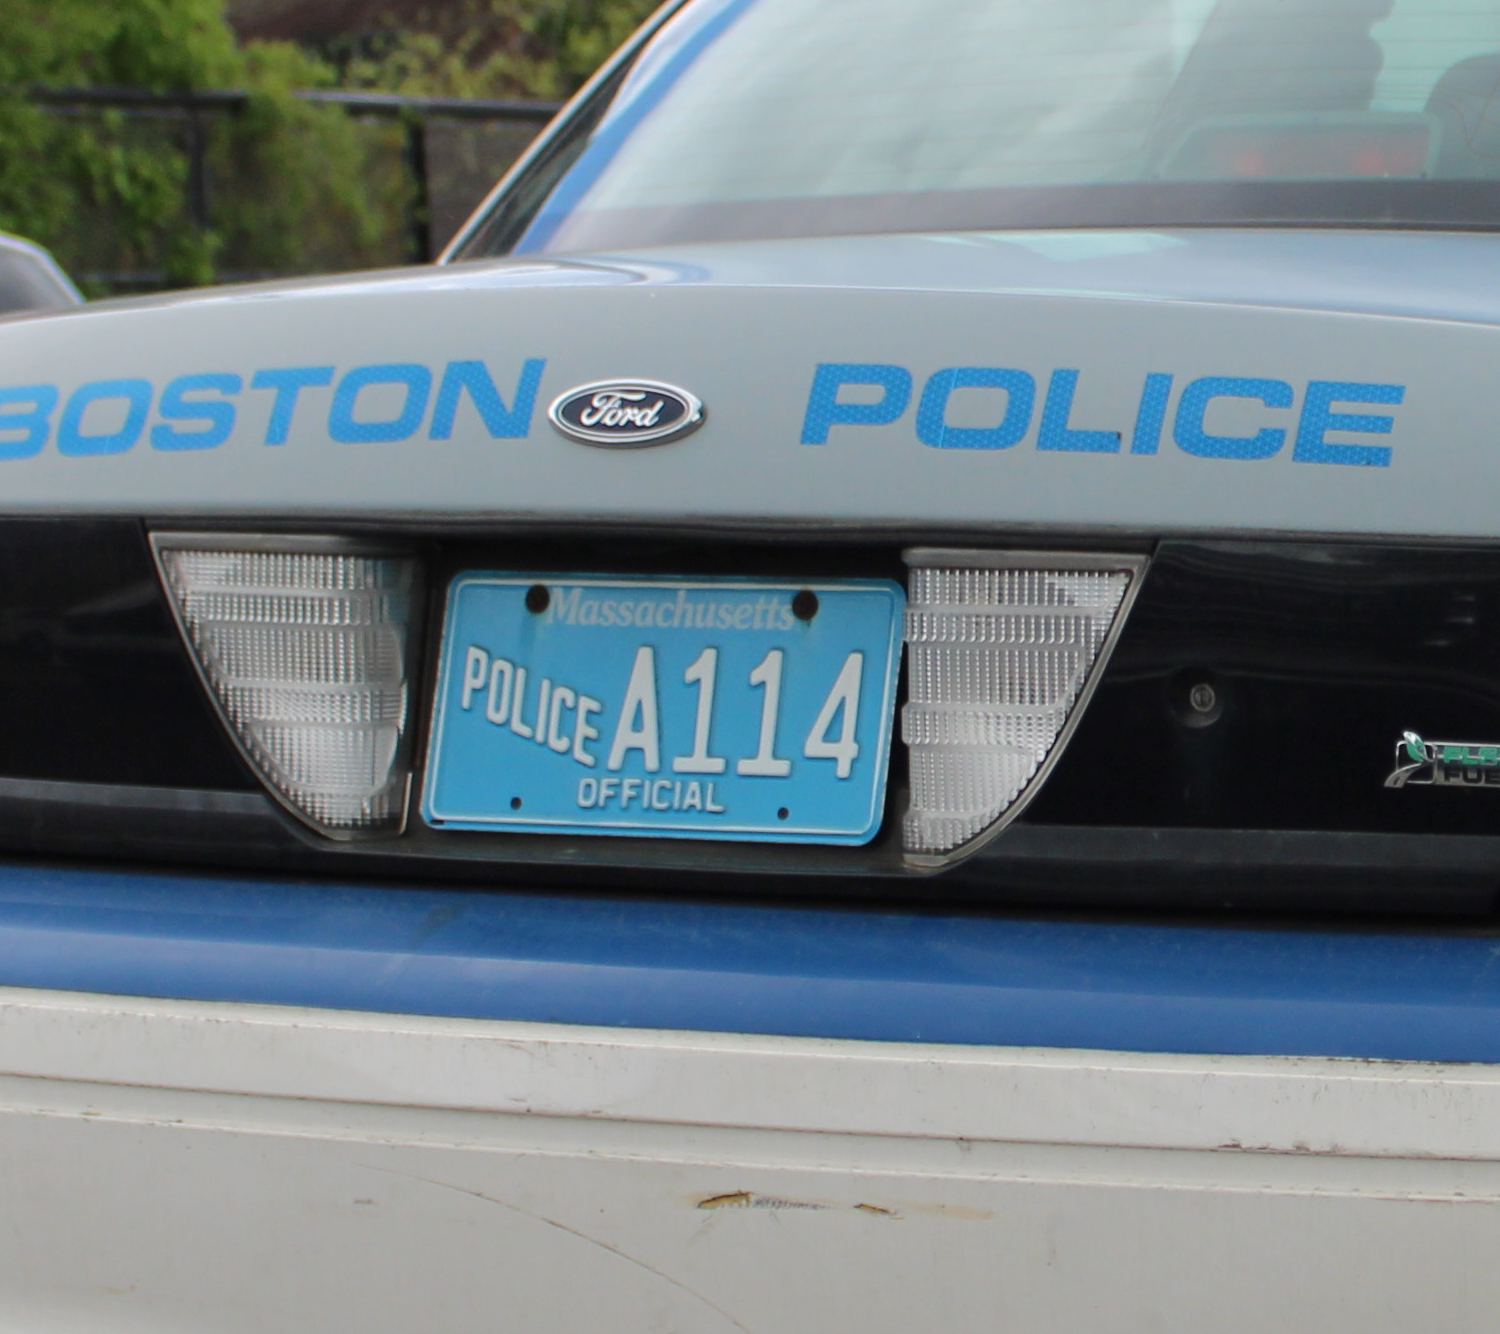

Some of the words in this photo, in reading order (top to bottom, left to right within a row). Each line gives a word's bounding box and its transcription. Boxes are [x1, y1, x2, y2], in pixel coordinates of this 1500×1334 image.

[579, 390, 665, 428] Ford
[800, 362, 1406, 467] POLICE
[545, 586, 797, 632] Massachusetts
[460, 644, 603, 768] POLICE
[606, 644, 865, 780] A114
[576, 777, 726, 814] OFFICIAL
